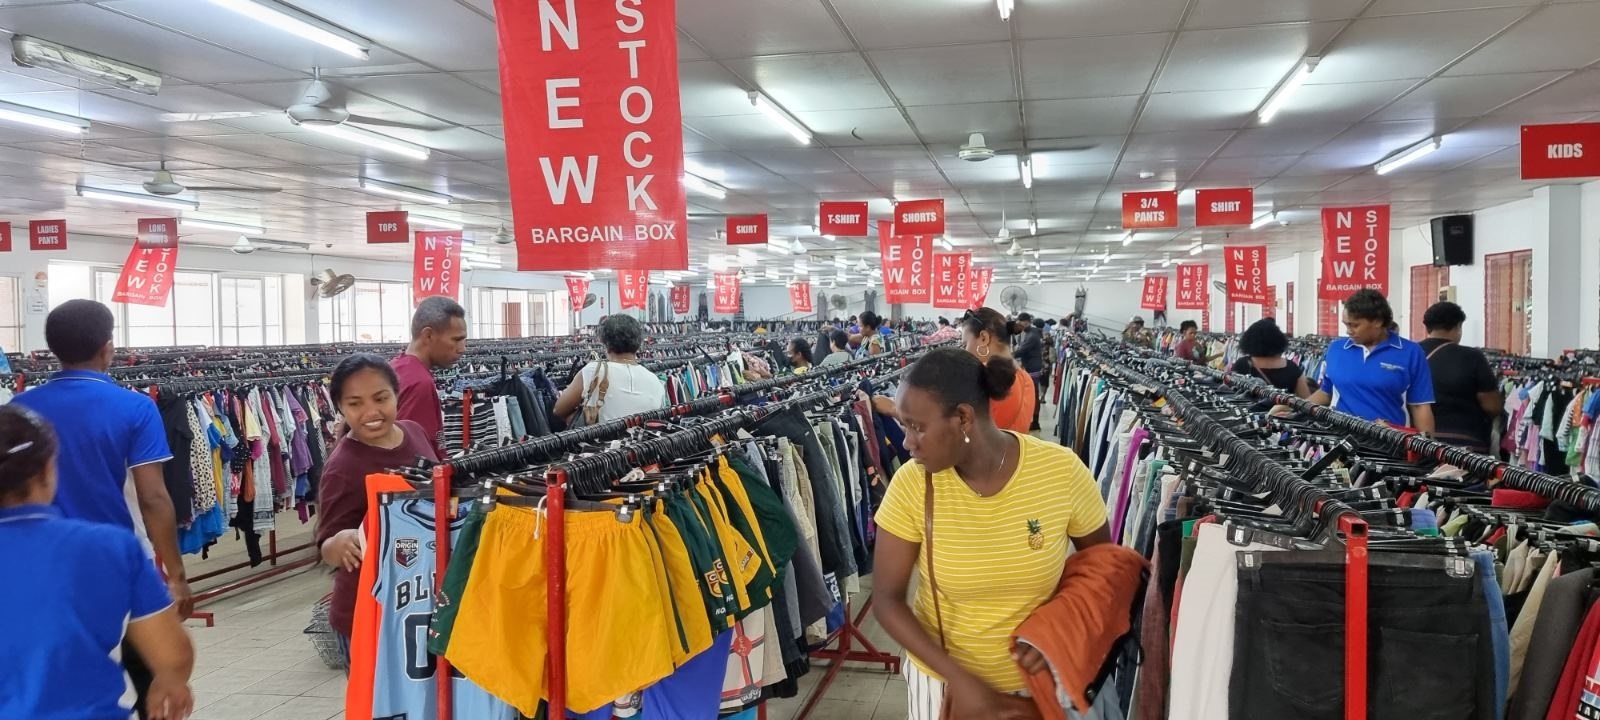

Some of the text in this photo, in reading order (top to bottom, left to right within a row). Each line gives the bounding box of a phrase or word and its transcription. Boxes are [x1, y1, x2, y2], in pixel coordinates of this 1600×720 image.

[537, 0, 599, 205] NEW
[615, 0, 658, 211] STOCK
[1547, 143, 1583, 159] KIDS
[1140, 198, 1159, 209] 3/4
[1211, 201, 1240, 213] SHIRT
[827, 214, 861, 224] T-SHIRT
[902, 212, 937, 223] SHORTS
[1134, 211, 1165, 222] PANTS
[37, 225, 59, 234] LADIES
[148, 224, 166, 233] LONG
[378, 223, 398, 232] TOPS
[531, 223, 676, 244] BARGAIN BOX
[735, 225, 758, 234] SKIRT
[38, 236, 59, 245] PANTS
[1333, 211, 1355, 278] NEW
[1364, 210, 1378, 280] STOCK
[420, 236, 436, 292] NEW
[440, 236, 454, 294] STOCK
[1233, 250, 1248, 291] NEW
[1252, 250, 1262, 294] STOCK
[940, 256, 953, 296] NEW
[957, 256, 966, 298] STOCK
[1181, 267, 1192, 300] NEW
[912, 288, 927, 296] BOX
[1326, 283, 1362, 291] BARGAIN
